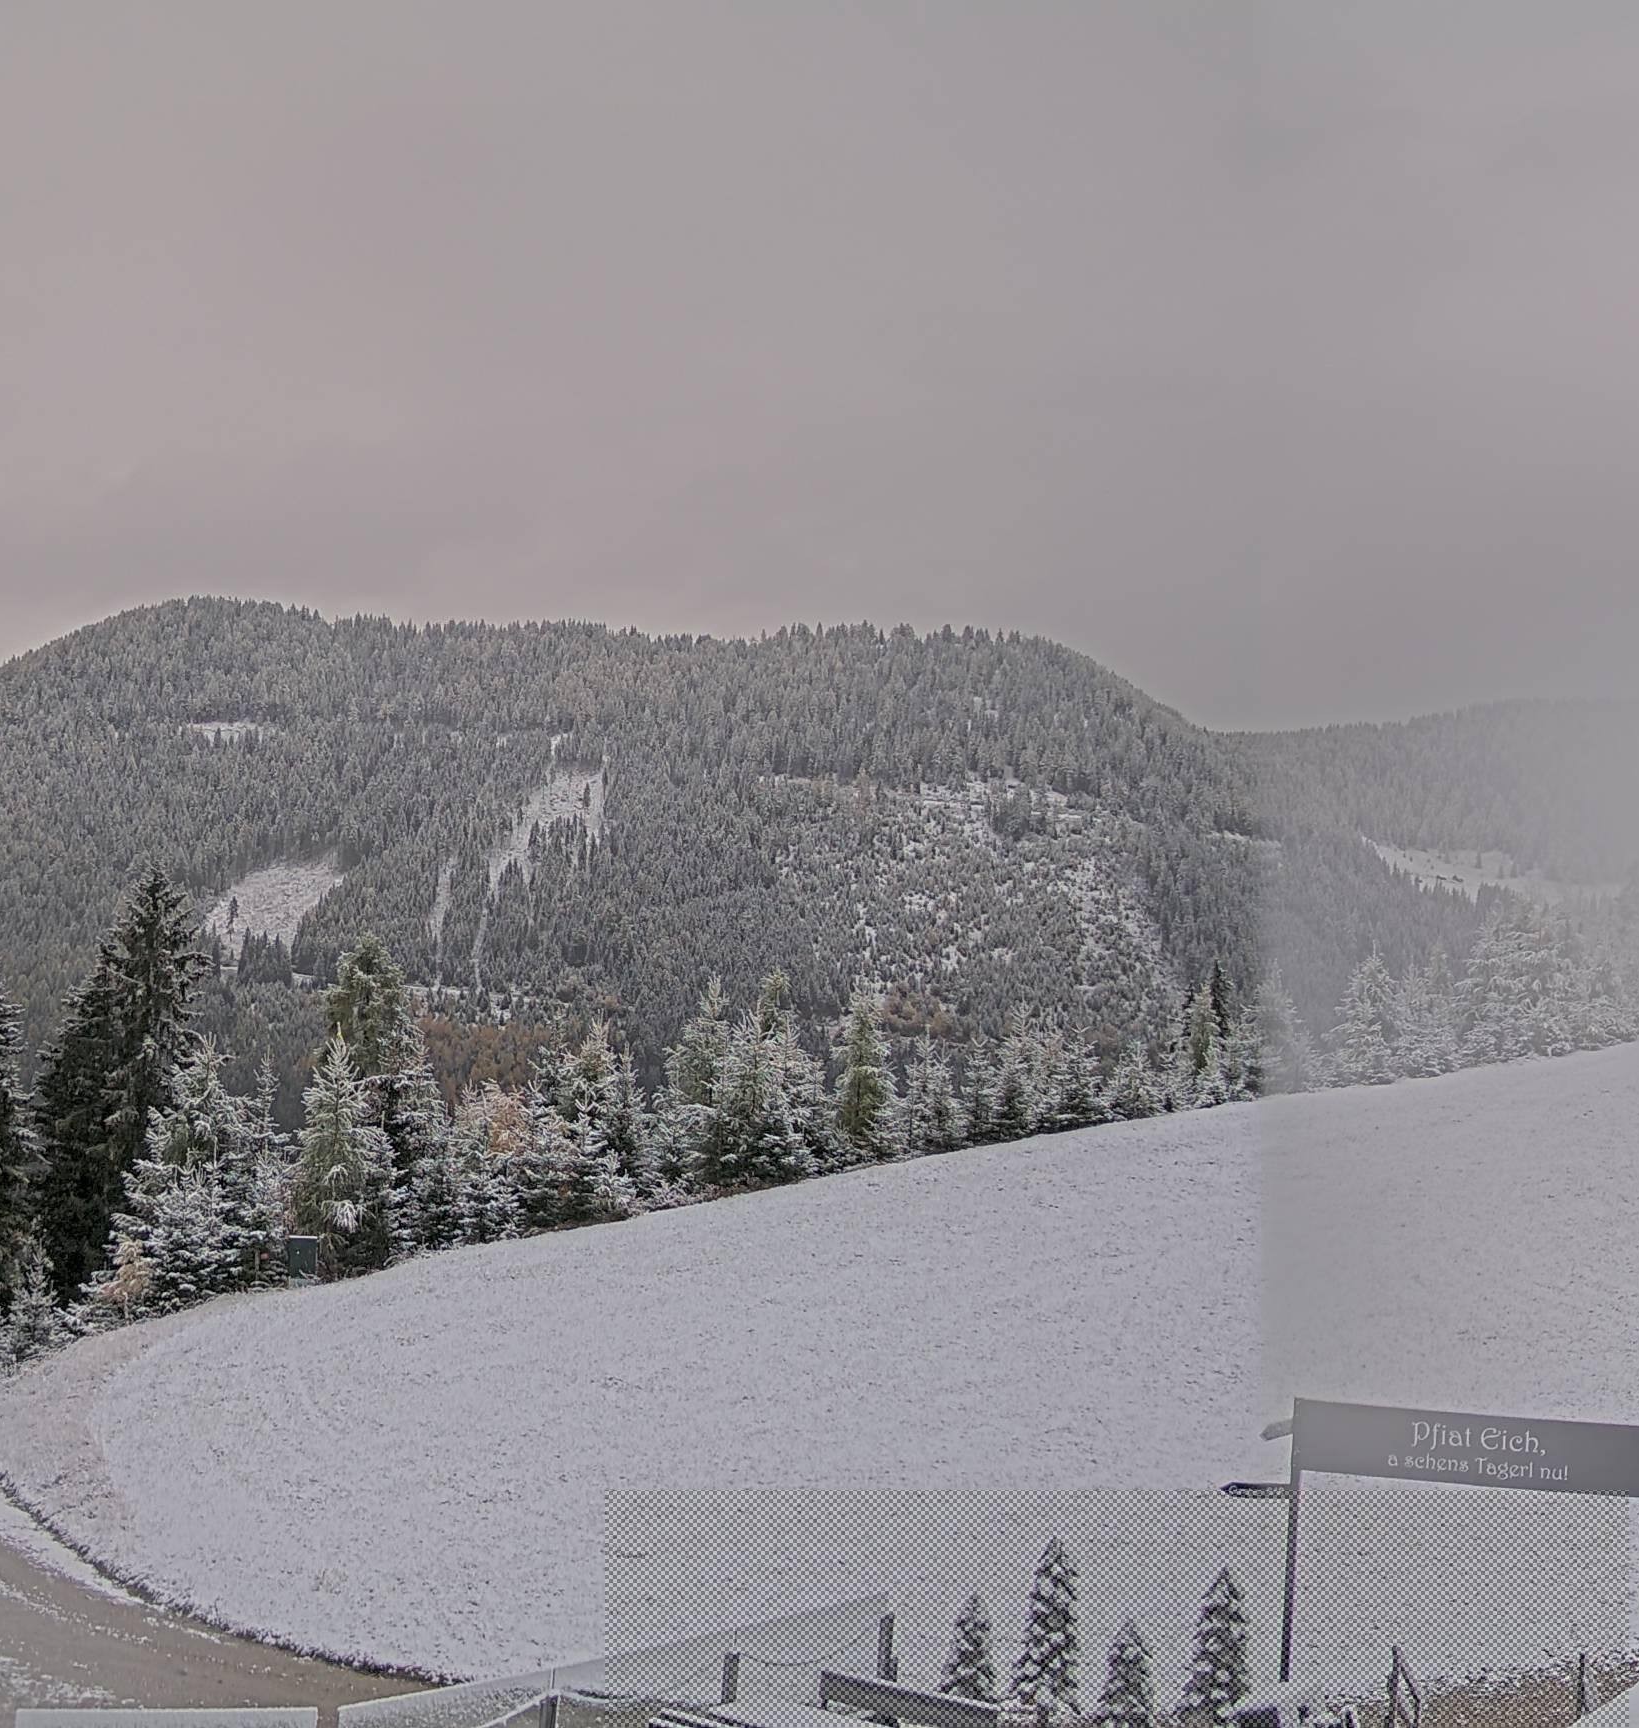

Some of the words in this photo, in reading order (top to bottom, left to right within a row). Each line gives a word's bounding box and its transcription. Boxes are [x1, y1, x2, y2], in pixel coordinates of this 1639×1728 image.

[1411, 1421, 1472, 1450] Pfiat
[1480, 1427, 1547, 1456] Eich,
[1387, 1454, 1398, 1467] a
[1404, 1453, 1470, 1473] schens
[1475, 1457, 1534, 1480] Tagerl
[1540, 1465, 1569, 1481] nu!
